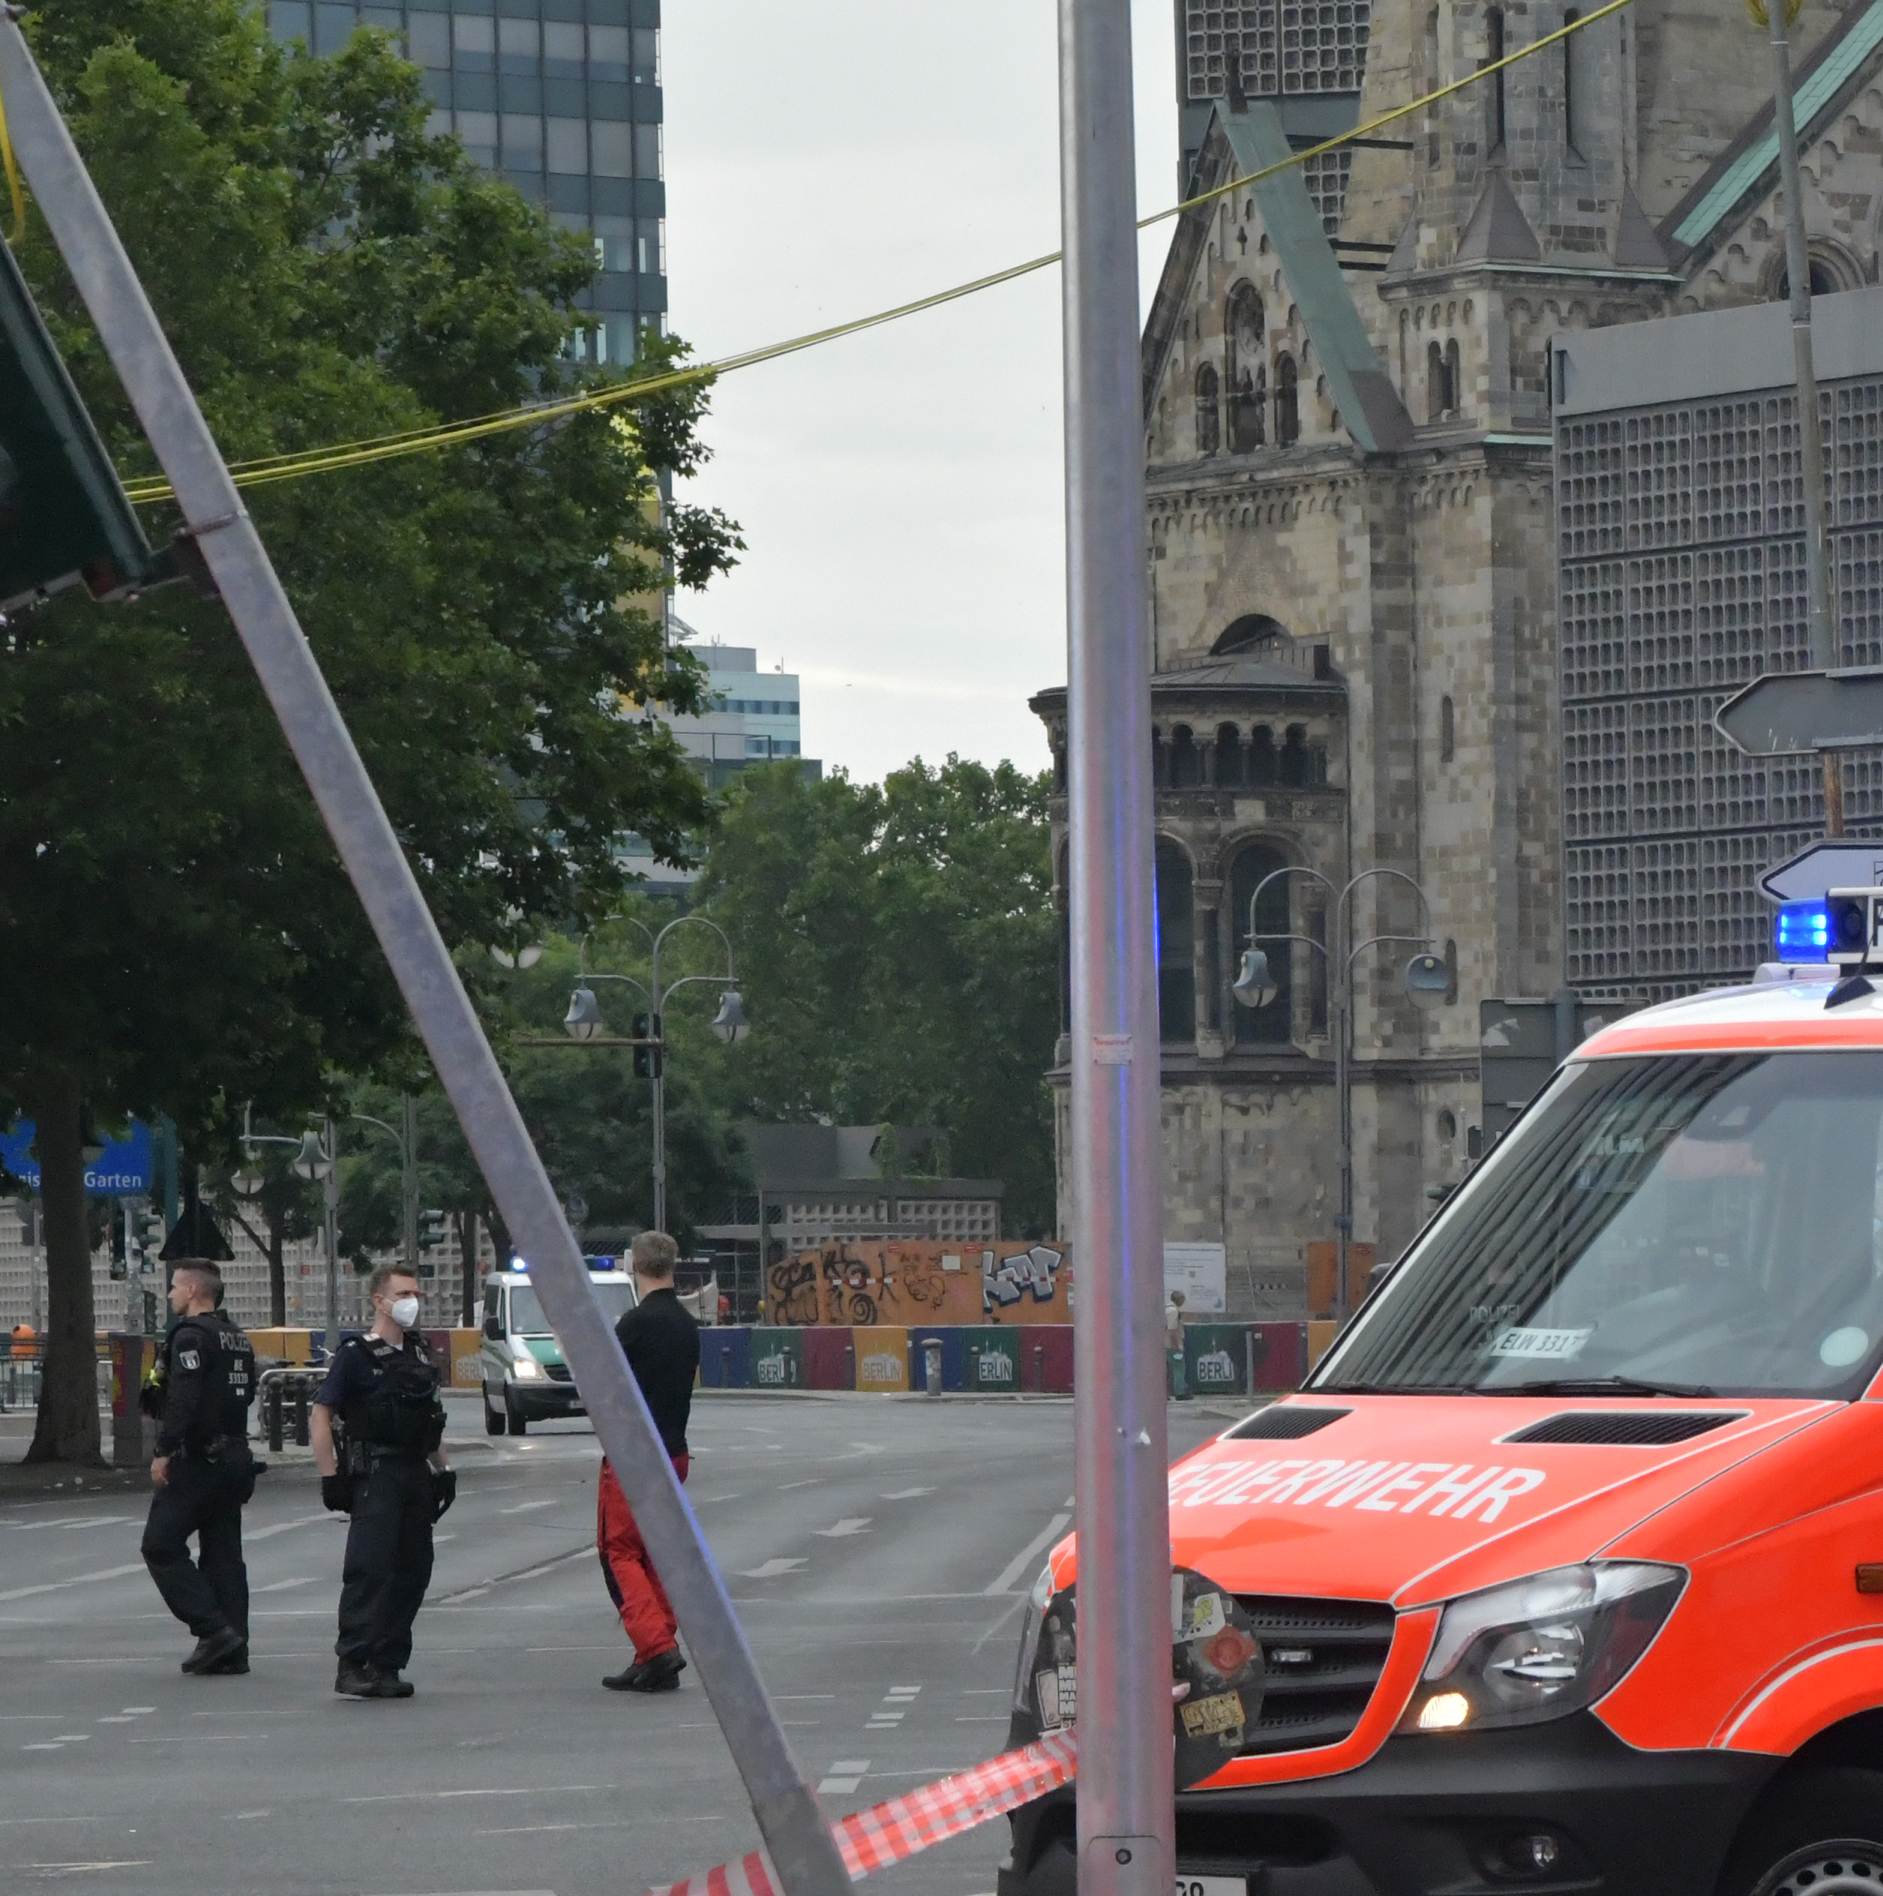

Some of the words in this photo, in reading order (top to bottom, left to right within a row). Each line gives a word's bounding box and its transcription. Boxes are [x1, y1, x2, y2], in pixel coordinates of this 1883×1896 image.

[84, 1171, 142, 1188] Garten
[1499, 1333, 1538, 1351] ELW
[863, 1362, 902, 1380] BERLIN
